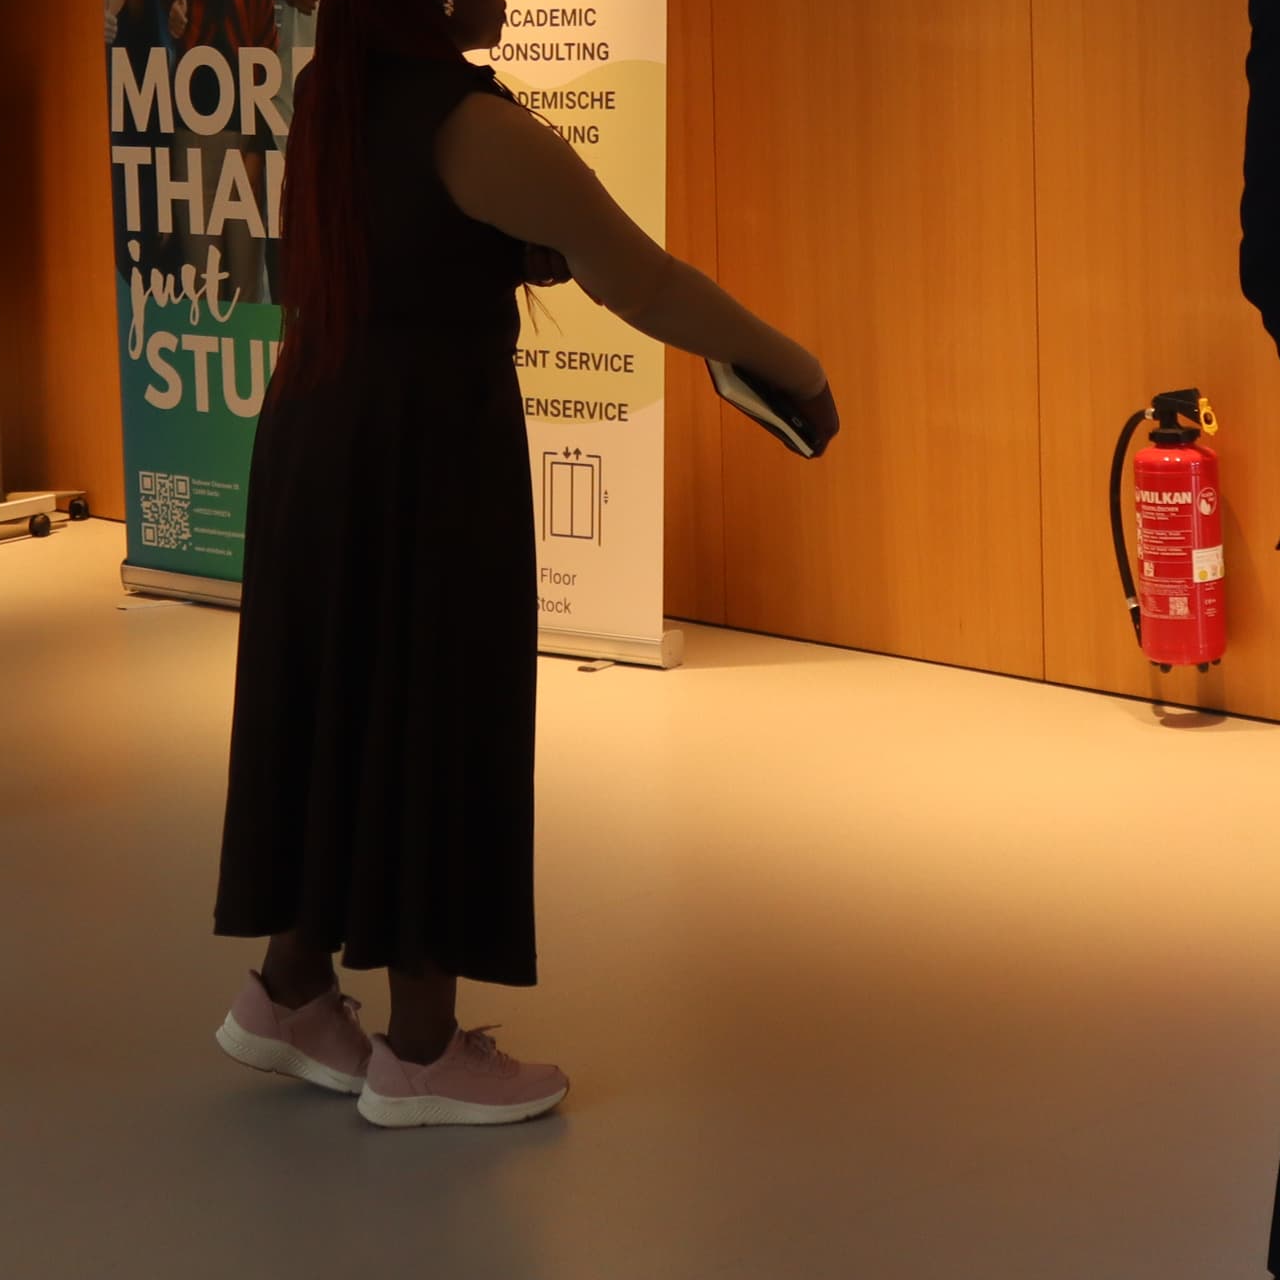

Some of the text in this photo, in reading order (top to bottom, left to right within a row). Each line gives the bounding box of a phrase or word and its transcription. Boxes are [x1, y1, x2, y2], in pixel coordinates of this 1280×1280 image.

[489, 42, 610, 62] CONSULTING
[517, 91, 616, 110] DEMISCHE
[126, 239, 241, 362] just
[514, 349, 635, 373] ENT SERVICE
[144, 330, 285, 419] STU
[524, 397, 629, 422] ENSERVICE
[1141, 491, 1192, 504] VULKAN
[540, 567, 577, 586] Floor
